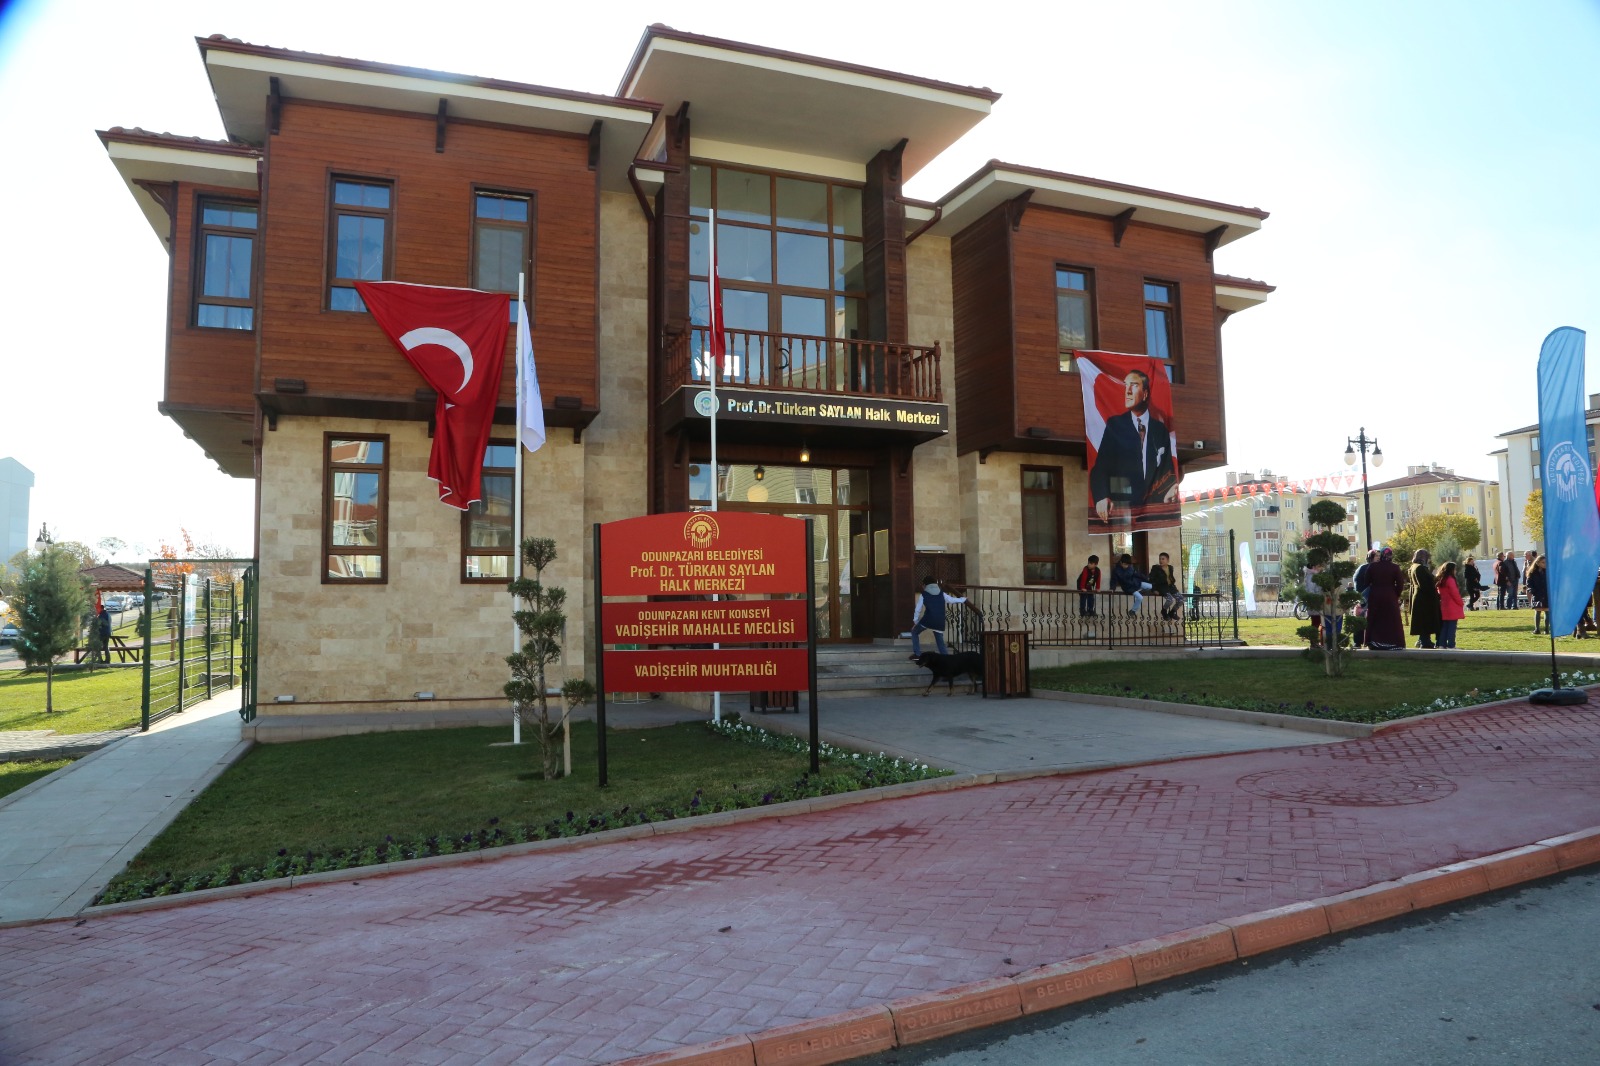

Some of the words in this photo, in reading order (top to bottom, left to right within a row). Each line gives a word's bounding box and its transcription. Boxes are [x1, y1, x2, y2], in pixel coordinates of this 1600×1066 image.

[819, 404, 862, 419] SAYLAN
[865, 407, 891, 421] Halk
[896, 409, 940, 425] Merkezi
[641, 550, 704, 562] ODUNPAZARI
[706, 547, 763, 561] BELEDİYESİ
[630, 565, 656, 578] Prof.
[660, 565, 675, 577] Dr.
[678, 562, 725, 577] TÜRKAN
[729, 563, 775, 576] SAYLAN
[660, 579, 690, 592] HALK
[694, 576, 745, 591] MERKEZİ
[638, 610, 699, 621] ODUNPAZARI
[701, 609, 726, 620] KENT
[729, 606, 770, 619] KONSEYİ
[615, 621, 679, 639] VADİŞEHİR
[682, 623, 741, 636] MAHALLE
[744, 618, 795, 635] MECLİSİ
[634, 661, 698, 680] VADİŞEHİR
[701, 660, 777, 677] MUHTARLIĞI
